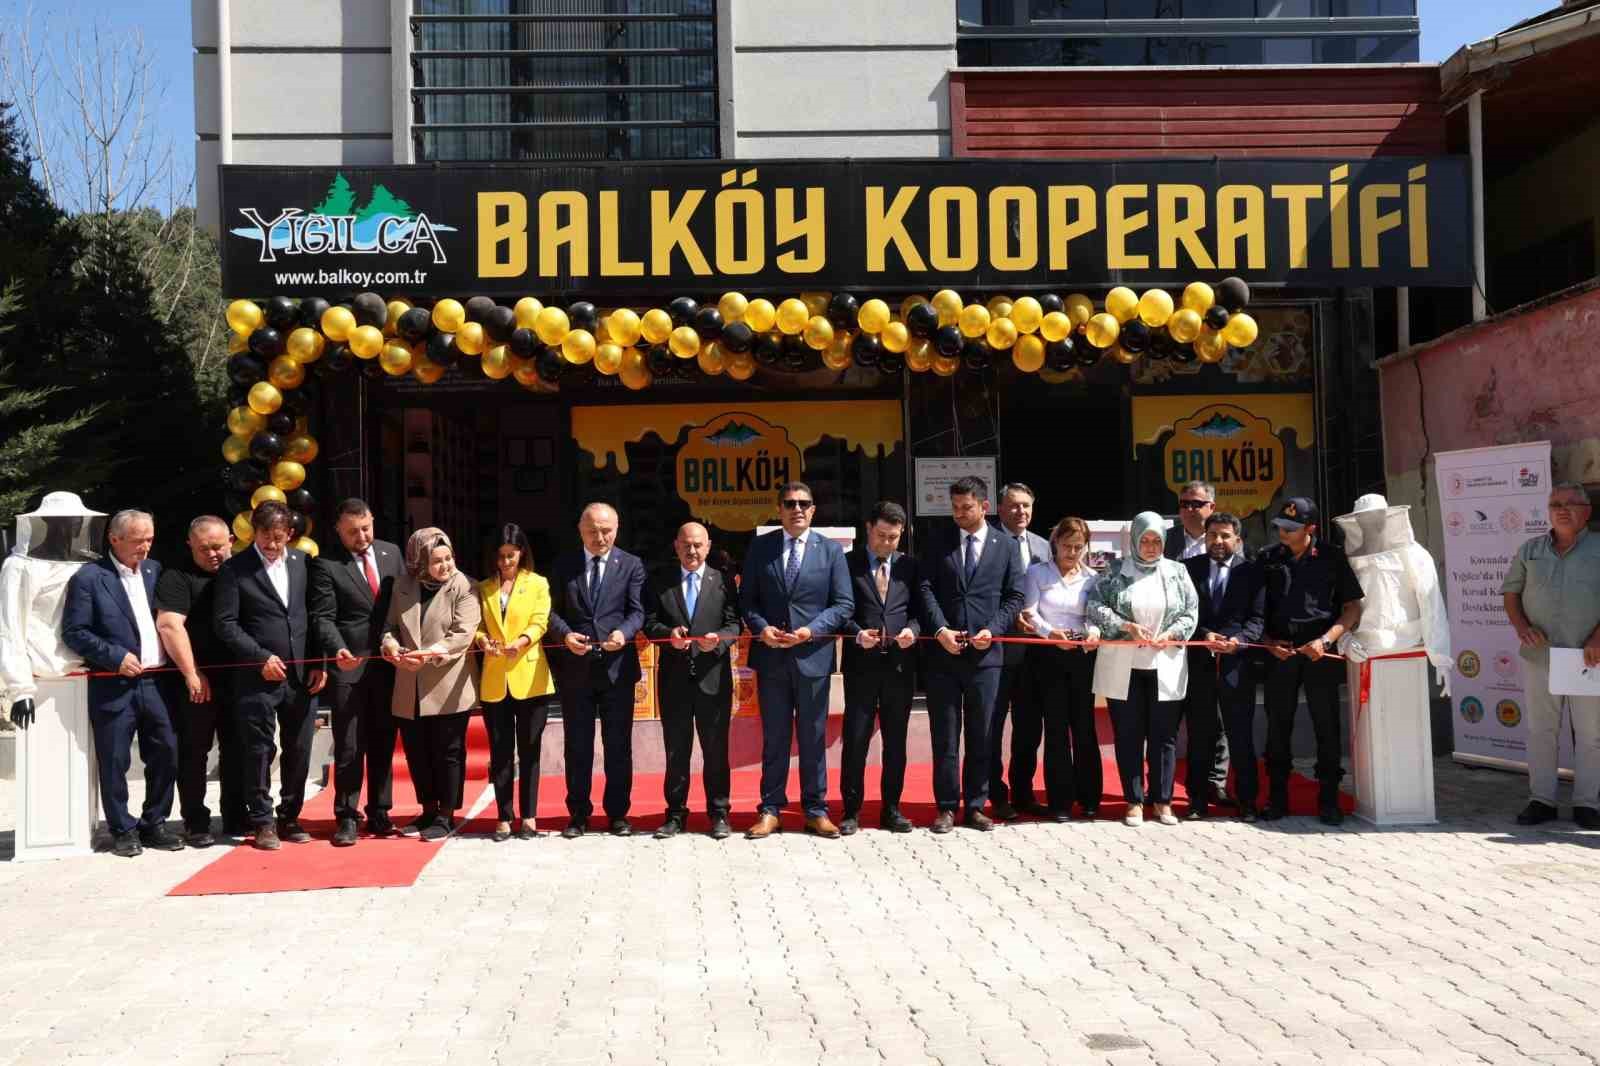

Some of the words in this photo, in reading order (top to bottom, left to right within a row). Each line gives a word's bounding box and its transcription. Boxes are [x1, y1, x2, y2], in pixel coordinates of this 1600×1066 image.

[476, 167, 827, 279] BALKÖY
[864, 163, 1430, 273] KOOPERATİFİ
[274, 269, 428, 288] www.balkoy.com.tr
[685, 448, 790, 492] BALKÖY
[1172, 441, 1274, 483] BALKÖY
